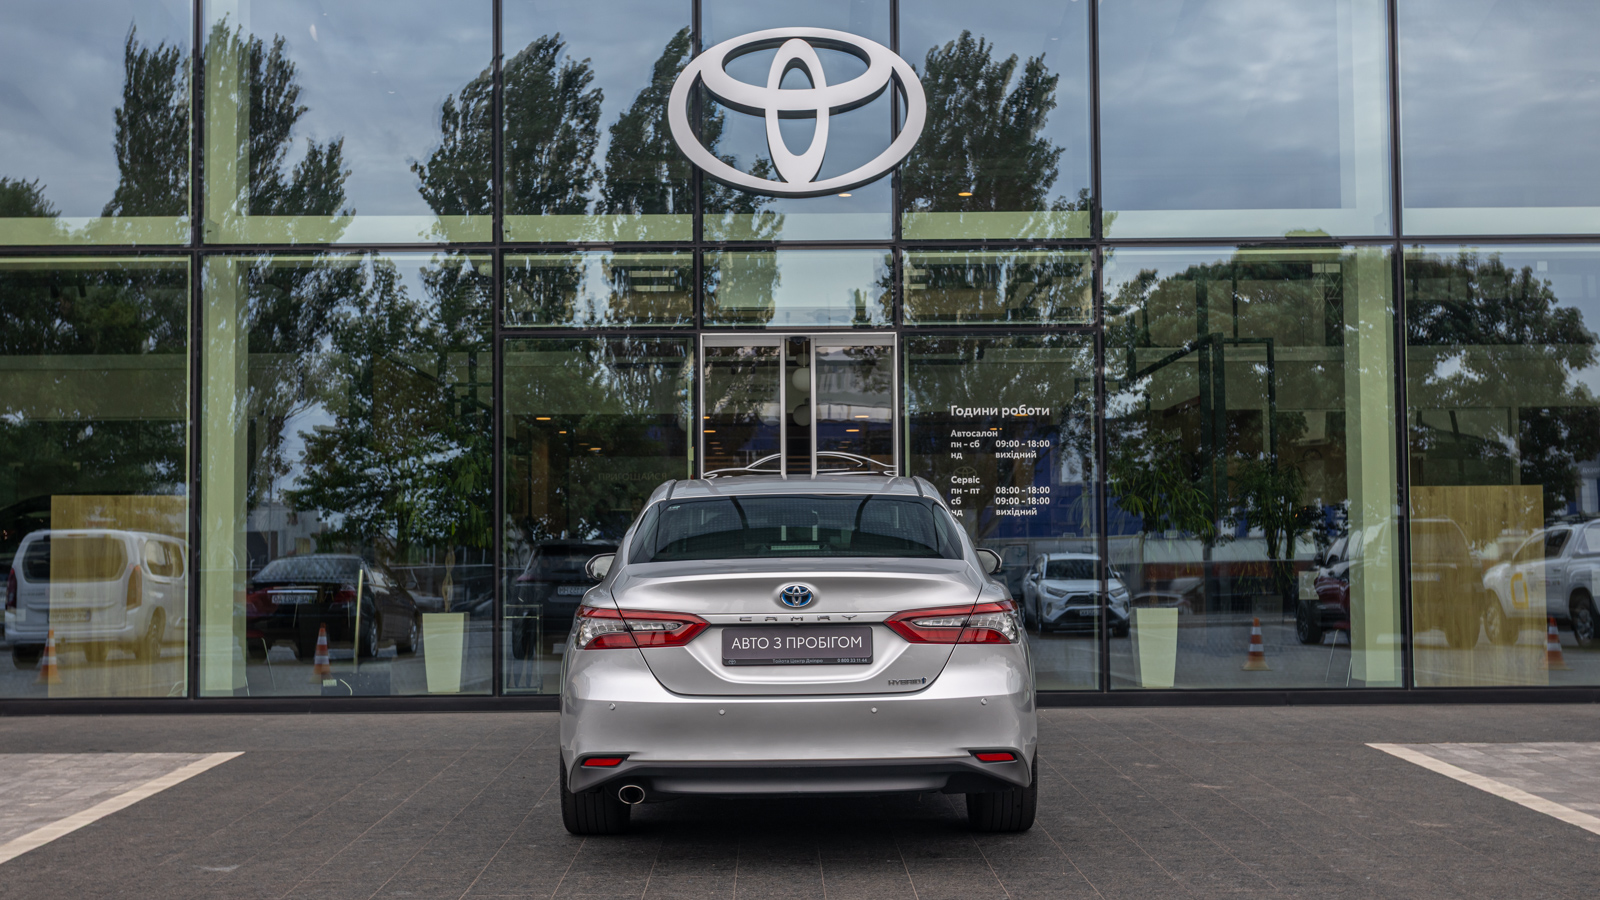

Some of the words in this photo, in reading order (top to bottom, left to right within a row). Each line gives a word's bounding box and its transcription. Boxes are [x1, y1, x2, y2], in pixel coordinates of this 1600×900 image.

[950, 405, 998, 417] Години
[1001, 404, 1050, 418] роботи
[950, 429, 998, 438] Автосалон
[969, 440, 980, 448] сб
[995, 440, 1020, 448] 09:00
[1027, 440, 1050, 448] 18:00
[950, 452, 963, 460] нд
[995, 450, 1037, 460] вихідний
[950, 476, 980, 485] Сервіс
[995, 486, 1020, 495] 08:00
[1027, 486, 1050, 495] 18:00
[950, 497, 962, 505] сб
[995, 497, 1020, 505] 09:00
[1027, 497, 1050, 505] 18:00
[995, 507, 1038, 517] вихідний
[739, 614, 858, 622] CAMRY
[731, 637, 770, 650] АВТО
[786, 636, 863, 649] ПРОБІГОМ
[887, 678, 922, 686] HYBRID
